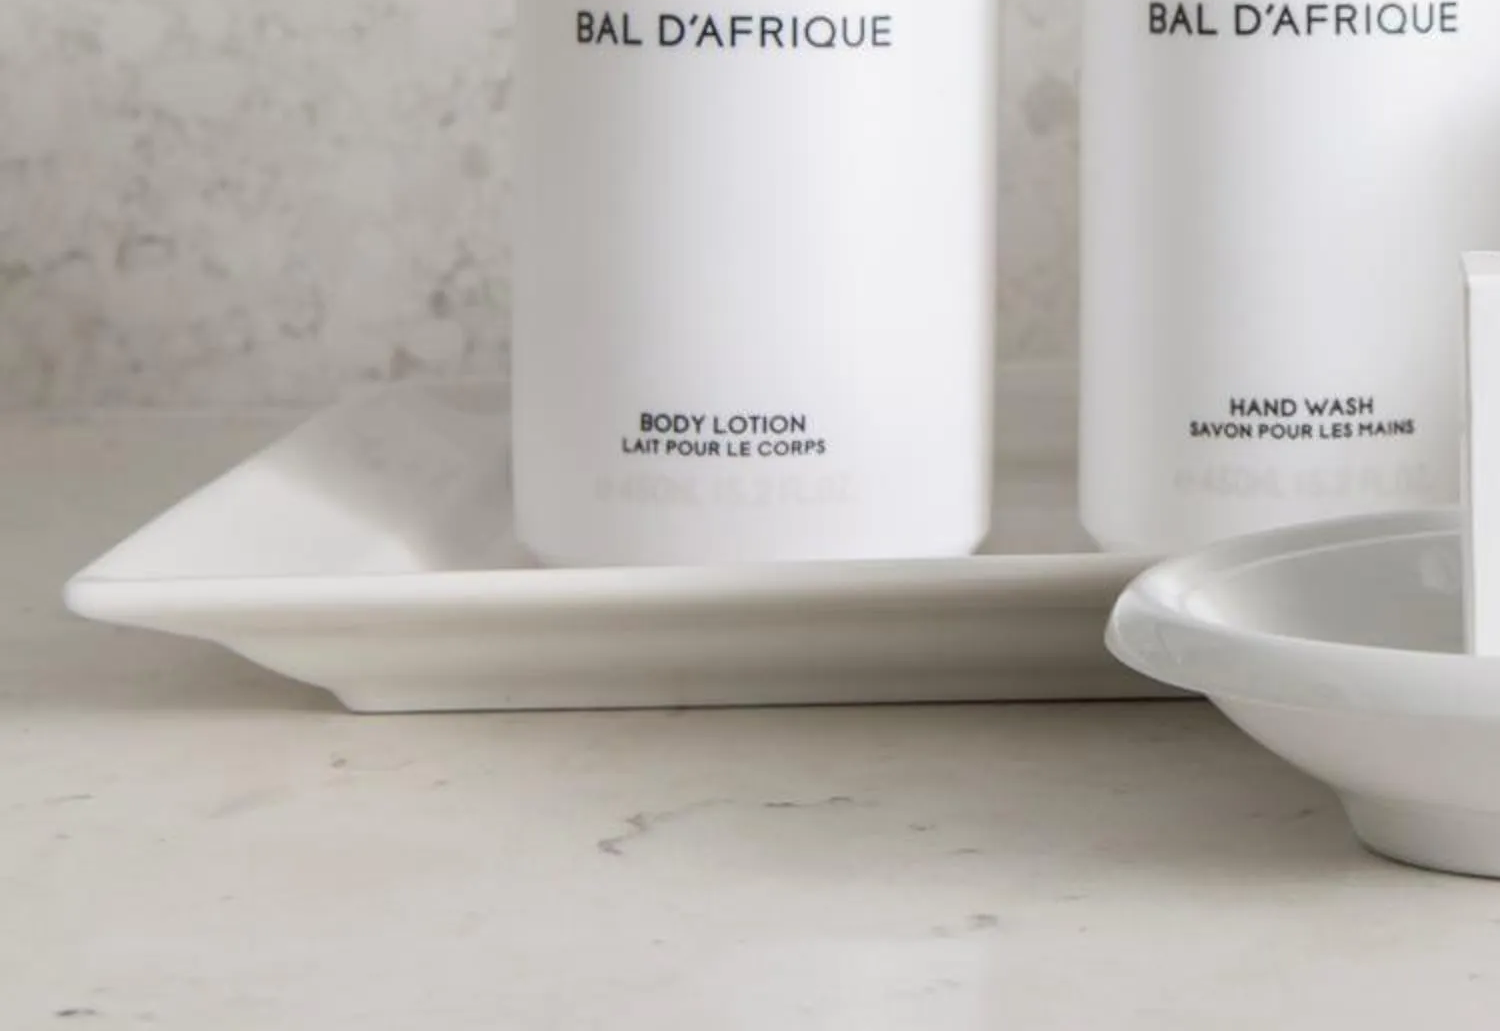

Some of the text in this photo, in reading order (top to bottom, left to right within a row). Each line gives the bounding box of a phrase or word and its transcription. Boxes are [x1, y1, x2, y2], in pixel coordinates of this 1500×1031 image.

[577, 10, 893, 48] BAL D'AFRIQUE
[1148, 1, 1458, 36] BAL D'AFRIQUE
[1229, 396, 1374, 417] HAND WASH
[640, 412, 807, 435] BODY LOTION
[1189, 418, 1415, 440] SAVON POUR LES MAINS
[622, 437, 827, 457] LAIT POUR LE CORPS
